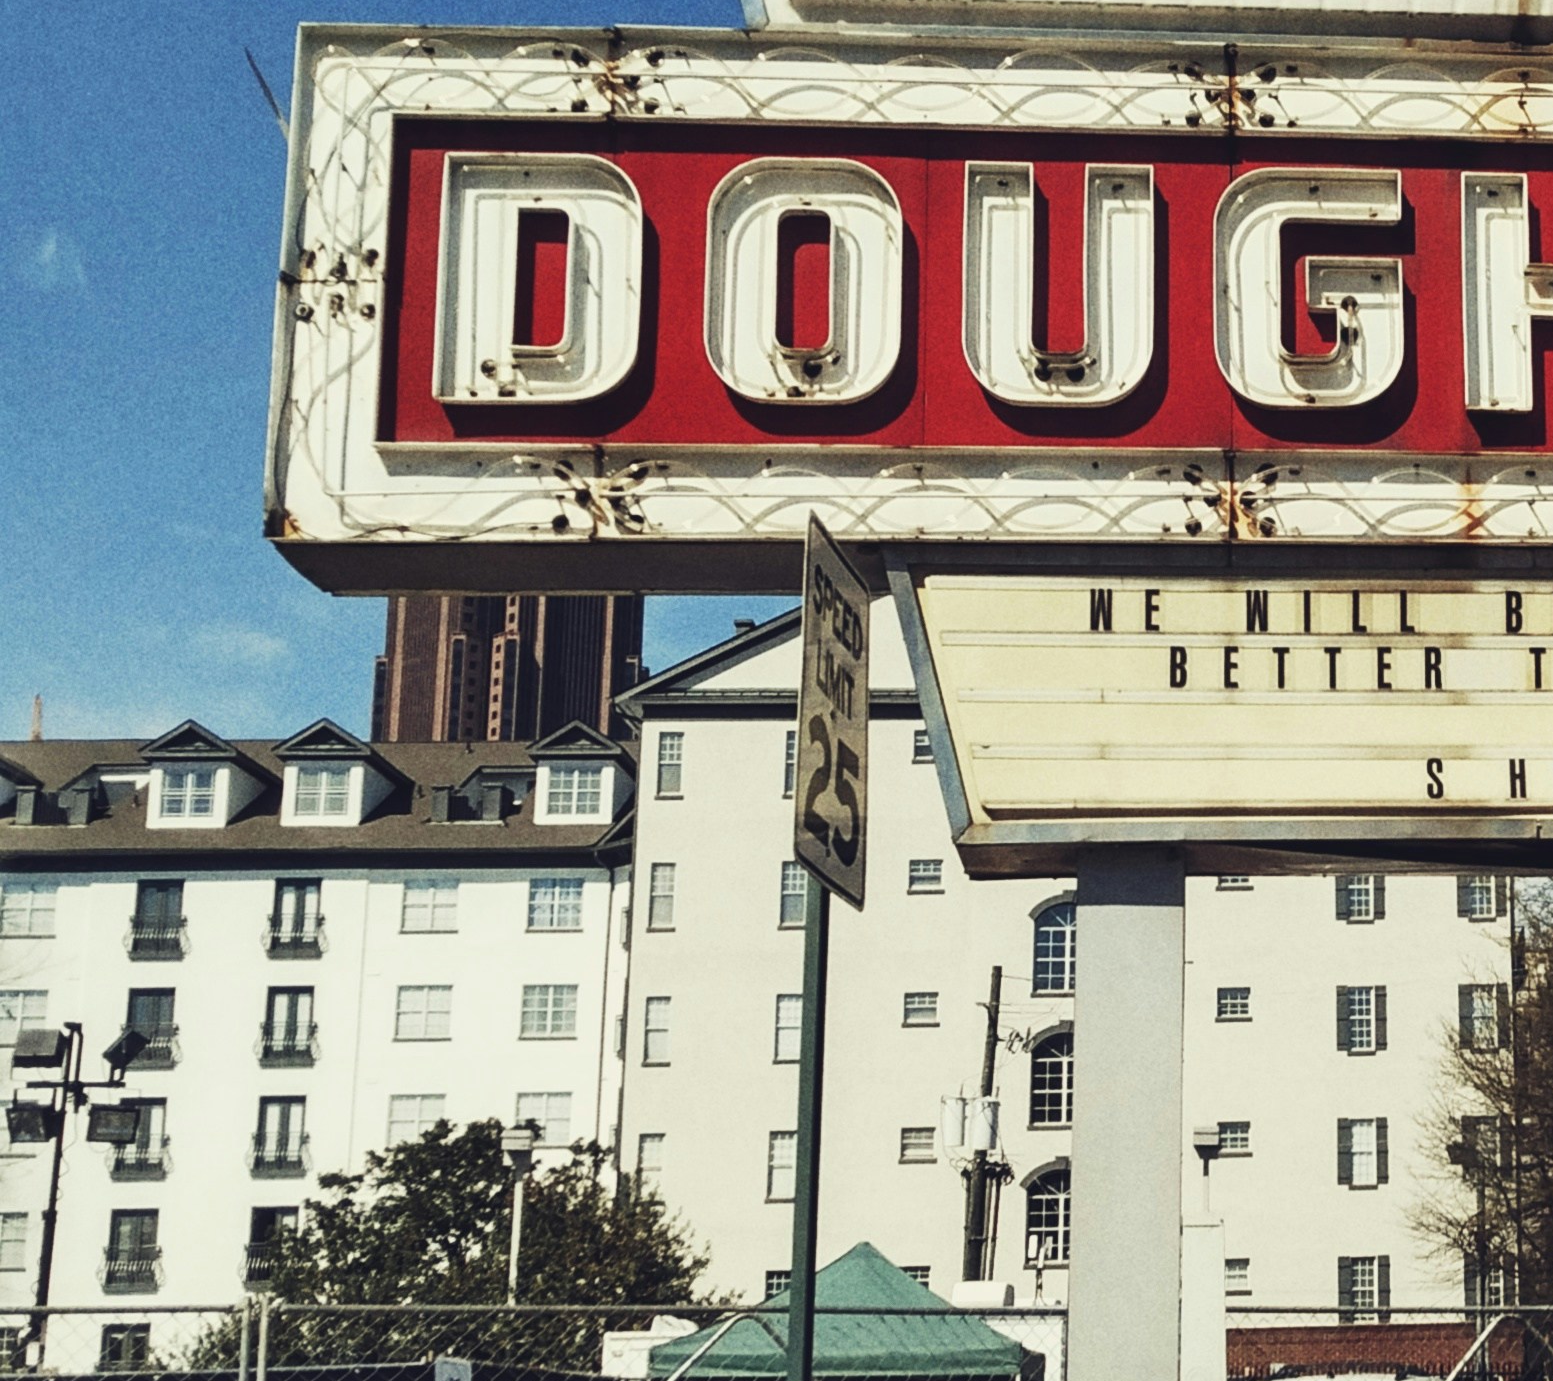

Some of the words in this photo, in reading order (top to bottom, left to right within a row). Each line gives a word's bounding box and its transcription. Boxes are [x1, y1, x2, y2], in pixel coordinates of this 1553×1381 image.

[813, 563, 864, 662] SPEED
[1089, 588, 1161, 633] WE
[1244, 589, 1416, 636] WILL
[816, 637, 856, 721] LIMIT
[1169, 645, 1443, 692] BETTER
[802, 714, 860, 868] 25
